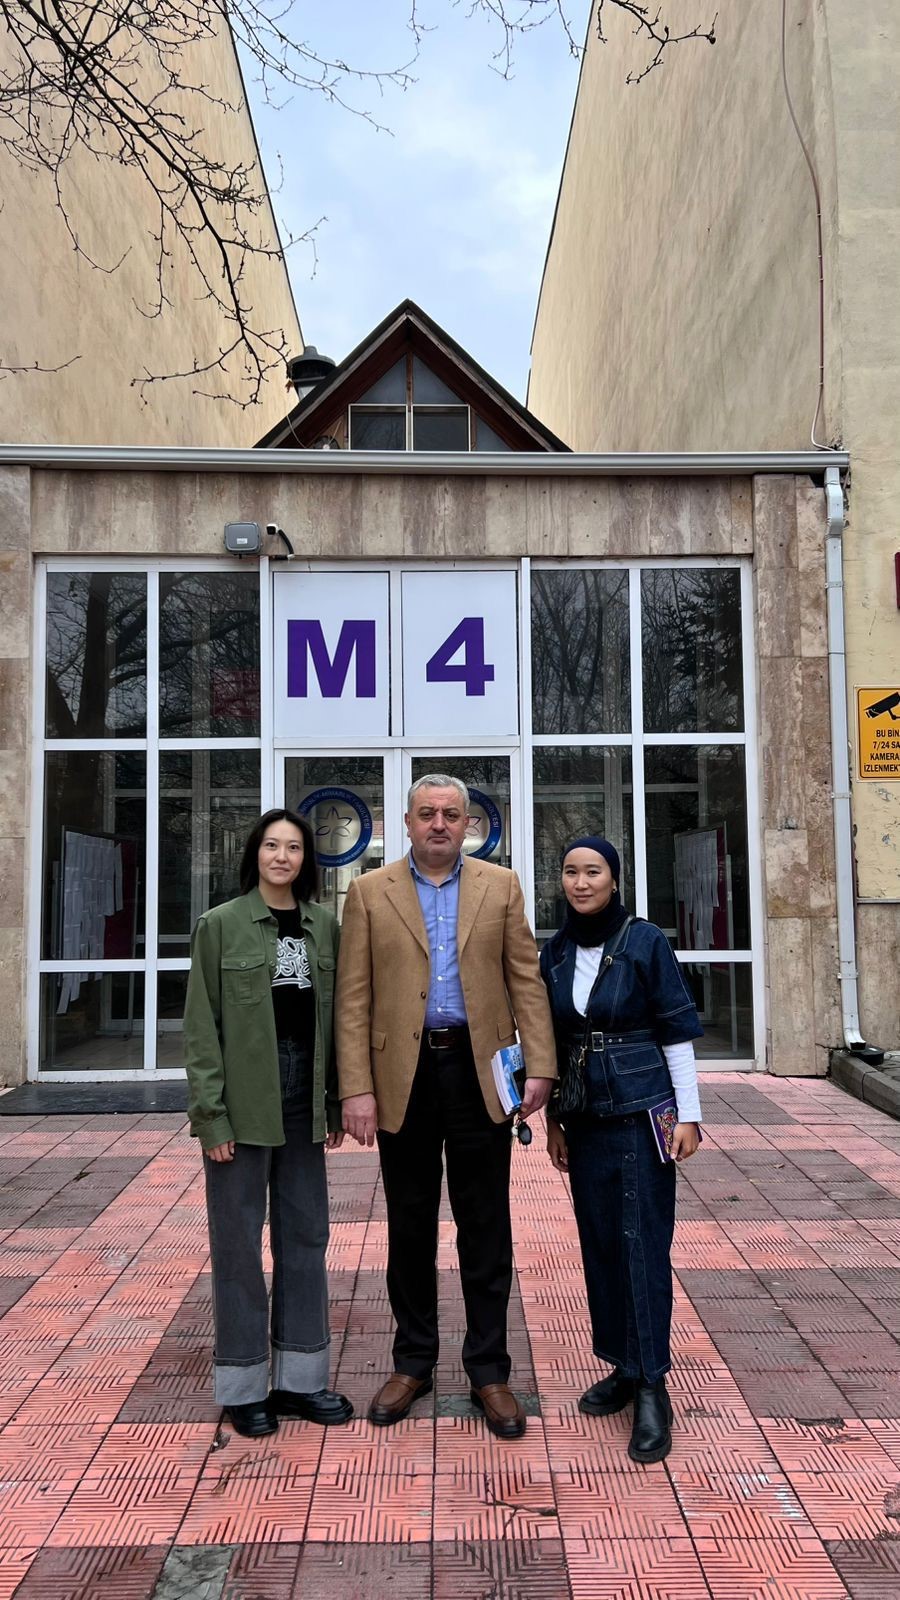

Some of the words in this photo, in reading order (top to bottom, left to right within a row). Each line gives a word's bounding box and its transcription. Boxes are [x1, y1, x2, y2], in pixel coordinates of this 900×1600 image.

[287, 619, 376, 698] M
[426, 617, 495, 696] 4
[876, 729, 886, 737] BU
[887, 727, 900, 737] BİN
[872, 741, 890, 750] 7/24
